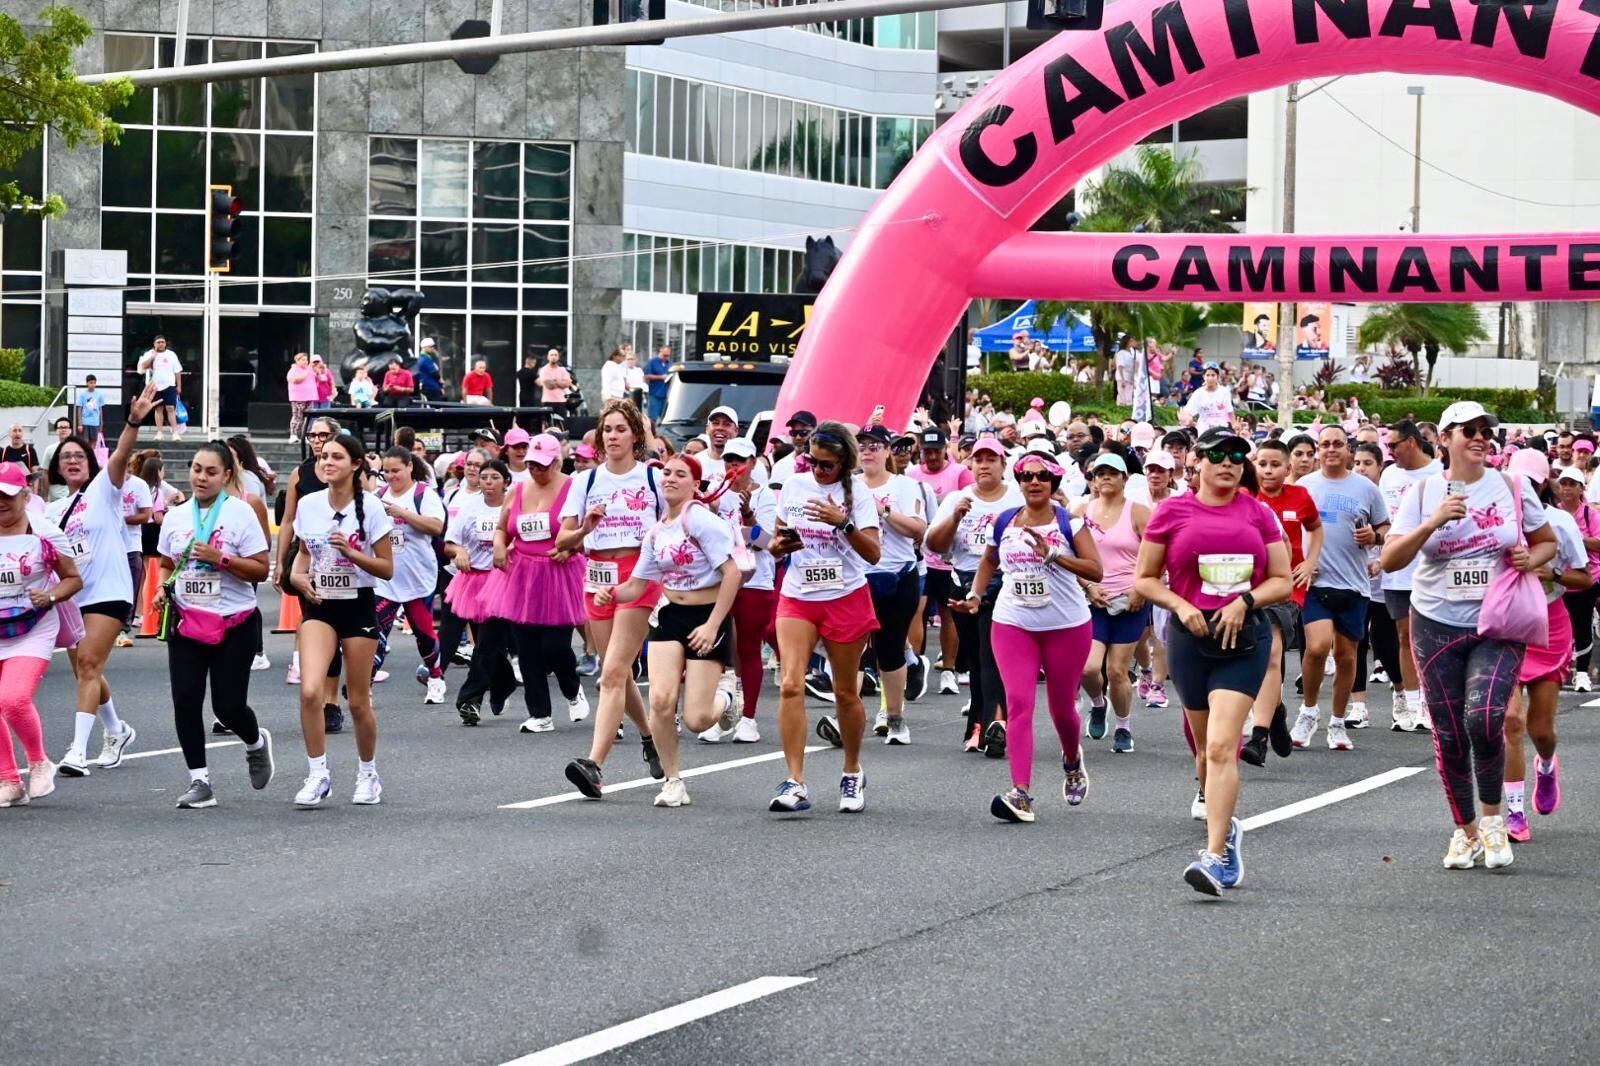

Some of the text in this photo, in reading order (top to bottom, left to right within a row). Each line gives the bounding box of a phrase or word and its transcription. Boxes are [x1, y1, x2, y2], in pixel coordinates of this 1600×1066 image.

[333, 287, 353, 300] 250
[708, 301, 760, 337] LA
[705, 341, 760, 353] RADIO
[521, 520, 544, 532] 6371
[974, 533, 986, 544] 76
[70, 543, 84, 556] 14
[0, 571, 15, 584] 40
[320, 575, 350, 587] 8020
[805, 568, 836, 582] 9538
[1453, 570, 1488, 585] 8490
[185, 581, 213, 594] 8021
[1014, 582, 1045, 595] 9133
